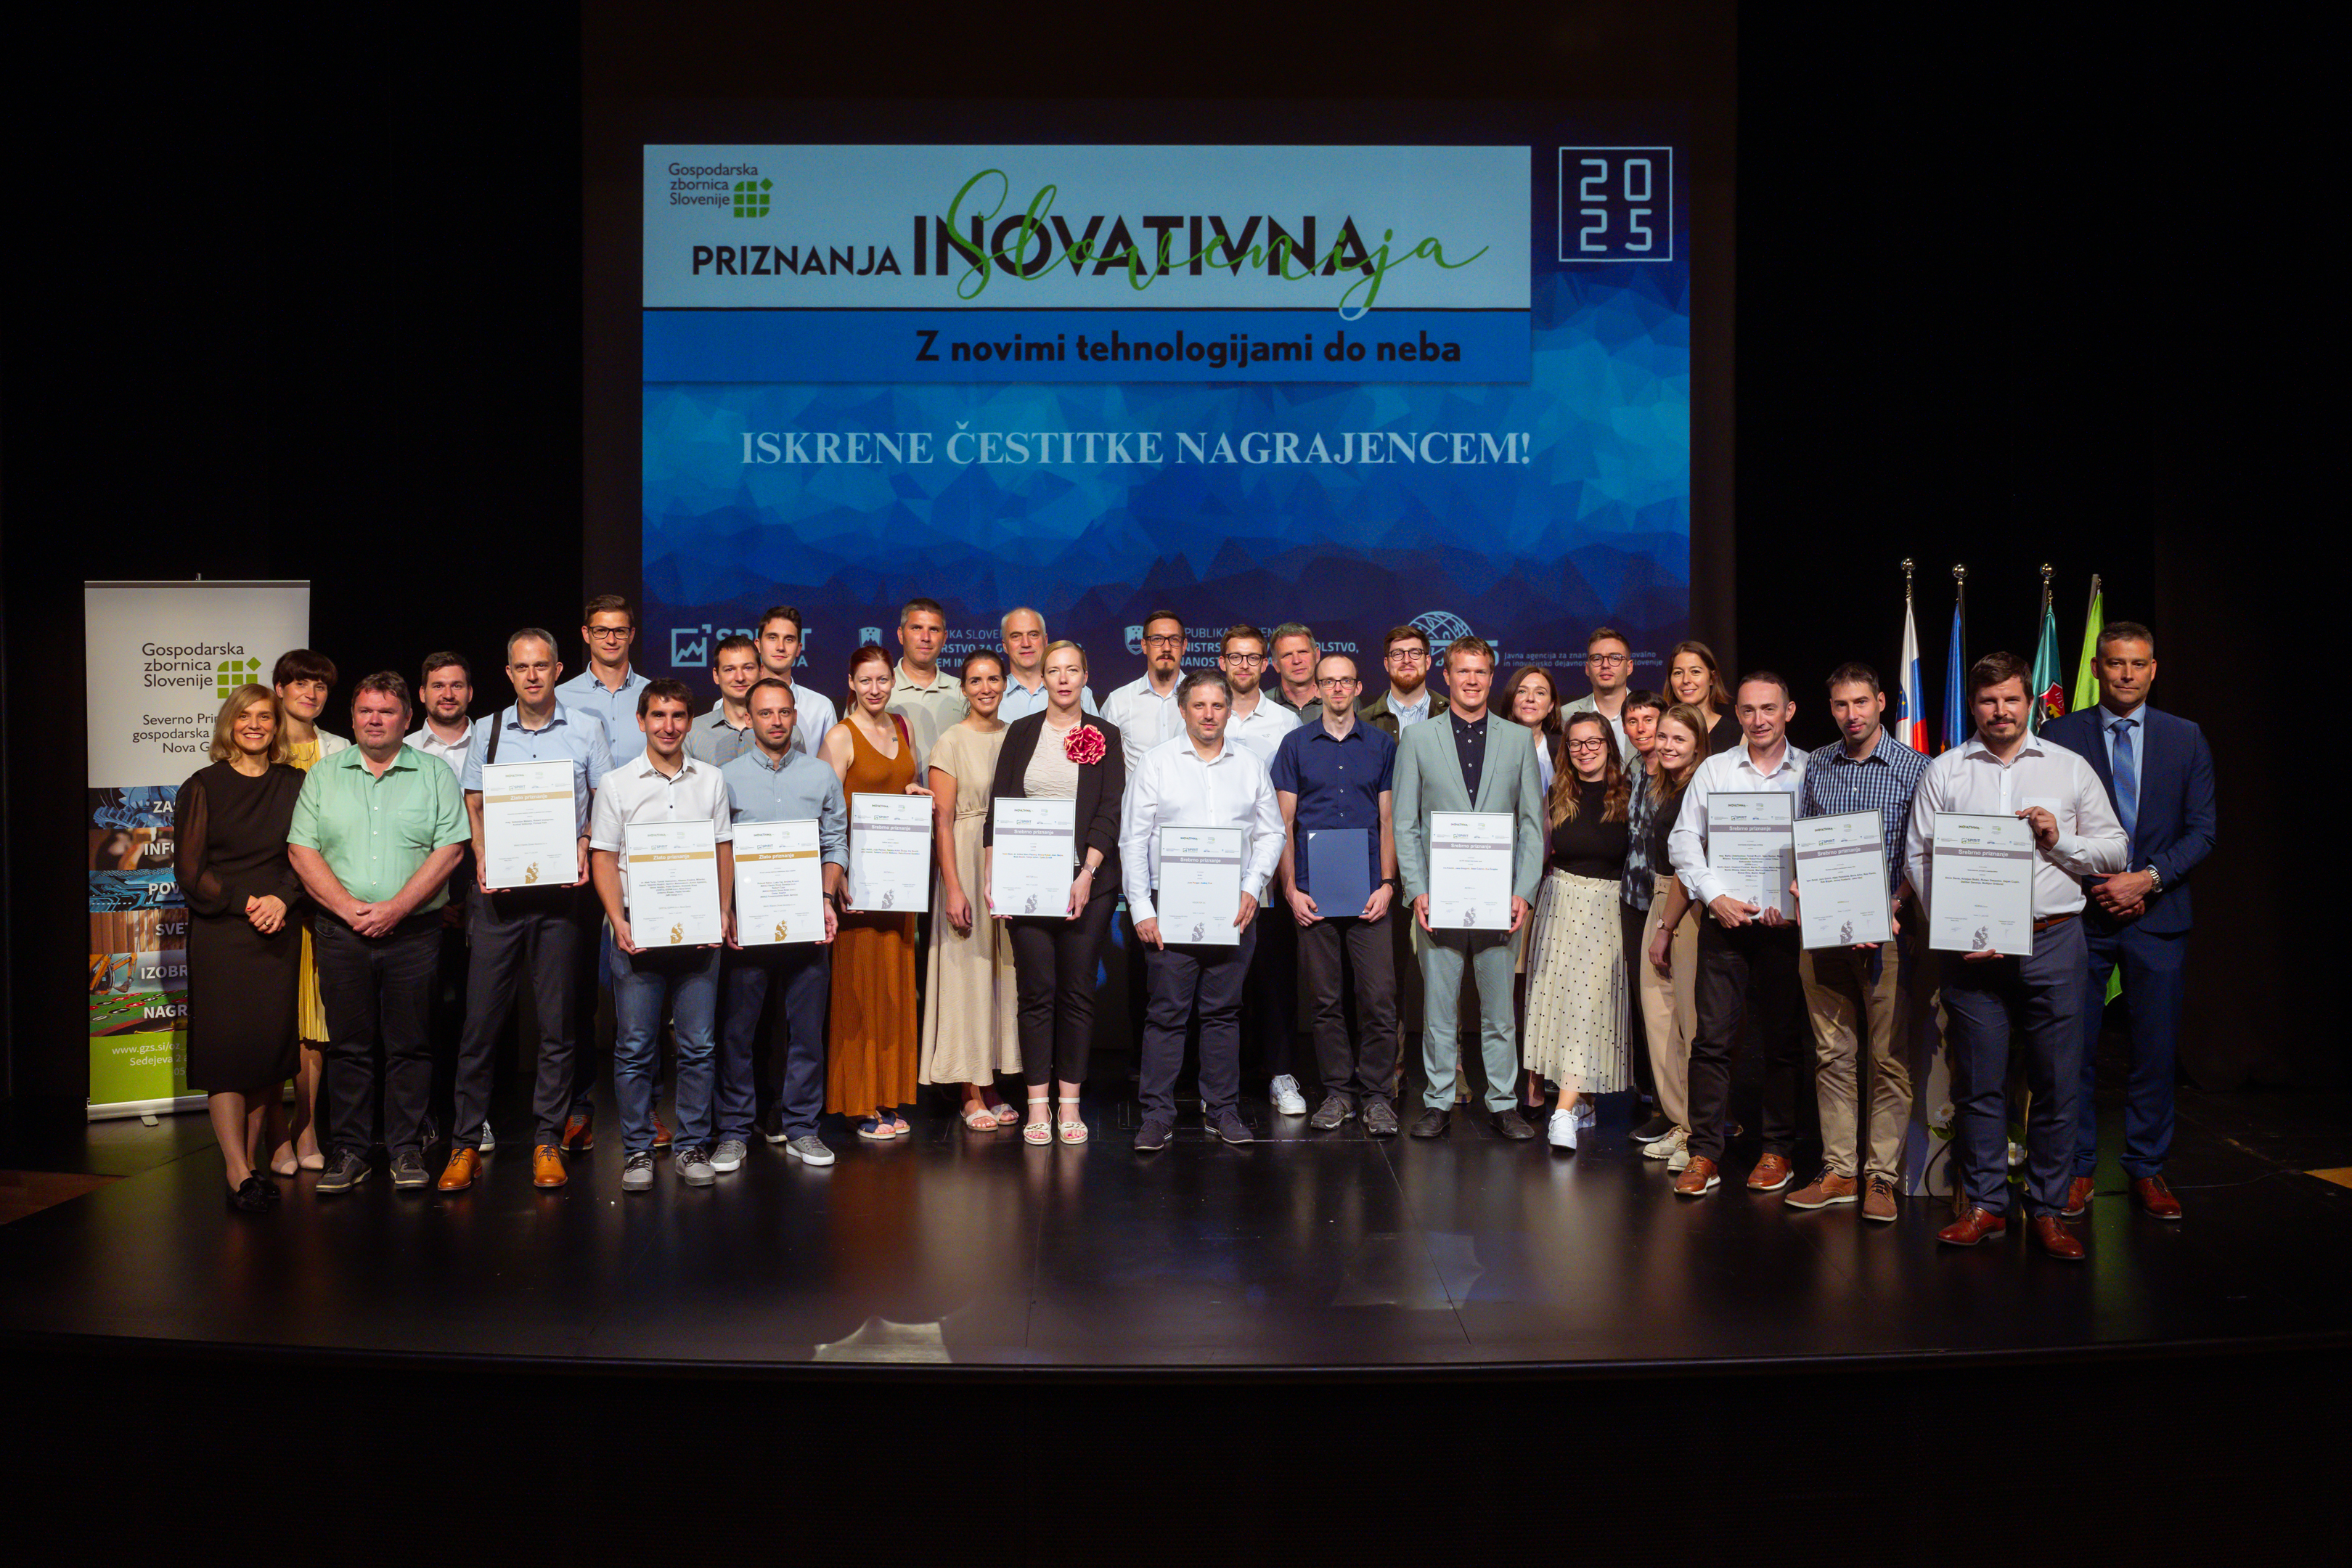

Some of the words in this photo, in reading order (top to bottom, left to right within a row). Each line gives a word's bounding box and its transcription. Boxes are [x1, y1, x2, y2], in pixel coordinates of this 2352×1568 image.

[669, 163, 758, 179] Gospodarska
[670, 177, 729, 191] zbornica
[1580, 158, 1652, 201] 20
[669, 192, 730, 209] Slovenije
[1580, 208, 1652, 251] 25
[693, 245, 902, 276] PRIZNANJA
[914, 214, 1376, 277] INOVATIVNA
[946, 168, 1490, 322] Slovenija
[915, 330, 939, 361] Z
[952, 333, 1065, 362] novimi
[1077, 330, 1313, 369] tehnologijami
[1323, 330, 1366, 362] do
[1376, 330, 1461, 362] neba
[740, 431, 934, 464] ISKRENE
[946, 420, 1164, 465] ČESTITKE
[1175, 431, 1531, 465] NAGRAJENCEM!
[966, 629, 1003, 639] SLOVE
[1185, 628, 1229, 638] PUBLIKA
[142, 642, 245, 659] Gospodarska
[1186, 642, 1221, 652] NISTRS
[144, 658, 211, 671] zbornica
[144, 674, 213, 690] Slovenije
[143, 714, 193, 725] Severno
[197, 714, 218, 724] Pri
[132, 727, 210, 743] gospodarska
[163, 743, 196, 753] Nova
[141, 965, 187, 979] IZOBR
[144, 1004, 187, 1019] NAGR
[112, 1042, 186, 1055] www.gzs.si/oz_
[130, 1055, 173, 1066] Sedejeva
